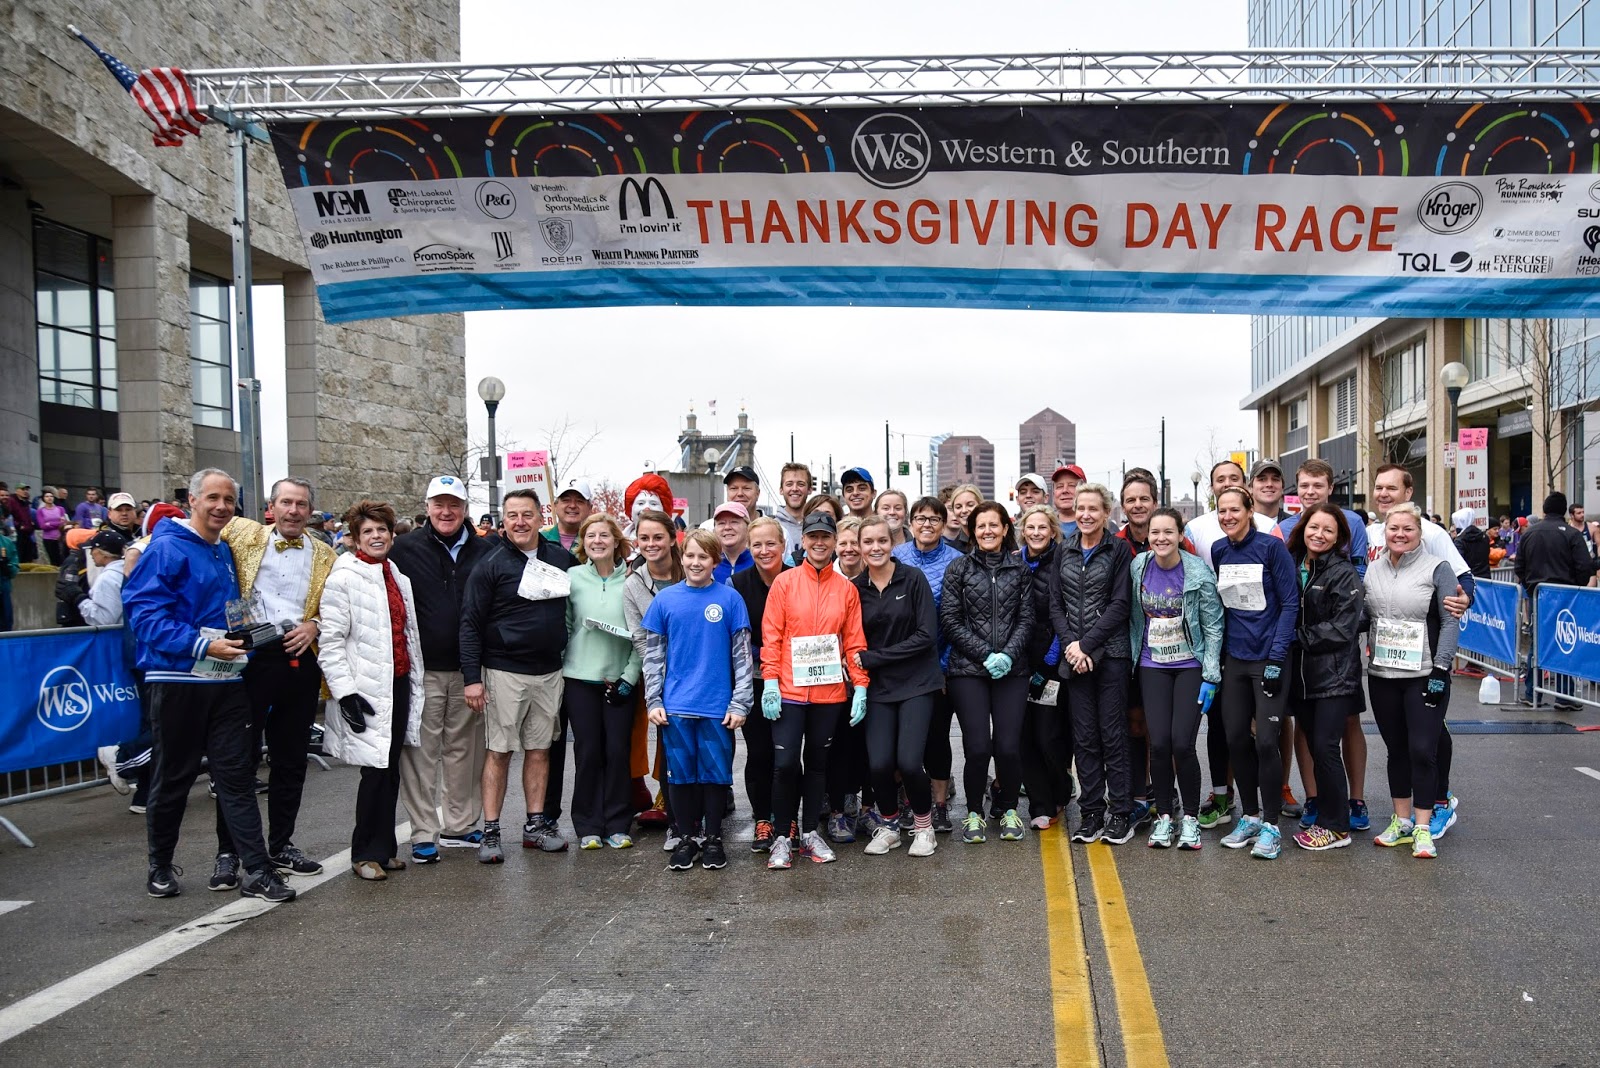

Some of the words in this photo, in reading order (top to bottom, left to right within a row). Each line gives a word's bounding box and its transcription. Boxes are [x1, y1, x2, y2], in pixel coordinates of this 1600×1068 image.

[857, 132, 924, 171] W&S
[939, 139, 1056, 167] Western
[1065, 141, 1092, 167] &
[1102, 138, 1230, 166] Southern
[1496, 177, 1516, 193] Bob
[421, 189, 453, 197] Lookout
[543, 194, 598, 204] Orthopaedics
[599, 194, 608, 202] &
[1501, 191, 1538, 199] RUNNING
[400, 197, 456, 207] Chiropractic
[485, 193, 510, 207] P&G
[545, 203, 571, 213] Sports
[573, 202, 610, 213] Medicine
[1425, 192, 1477, 227] Kroger
[343, 216, 373, 224] ADVISORS
[686, 199, 1098, 248] THANKSGIVING
[1125, 203, 1232, 250] DAY
[1254, 204, 1399, 252] RACE
[620, 224, 637, 234] i'm
[640, 223, 670, 233] lovin'
[329, 228, 403, 244] Huntington
[413, 250, 475, 262] PromoSpark
[541, 255, 583, 263] ROEHR
[592, 249, 622, 260] WEALTH
[624, 248, 659, 260] PLANNING
[661, 248, 699, 259] PARTNERS
[1493, 255, 1548, 265] EXERCISE
[320, 263, 334, 271] The
[335, 260, 360, 269] Richter
[368, 255, 394, 267] Phillips
[394, 256, 407, 264] Co.
[1398, 253, 1446, 272] TQL
[1499, 264, 1549, 274] LEISURE
[1466, 455, 1478, 465] MEN
[515, 473, 543, 484] WOMEN
[1458, 488, 1487, 499] MINUTES
[1465, 499, 1487, 509] UNDER
[1557, 620, 1575, 645] W&S
[1160, 643, 1181, 657] 10067
[1387, 648, 1407, 661] 11942
[211, 660, 234, 673] 11860
[808, 665, 826, 677] 9631
[42, 682, 89, 719] W&S
